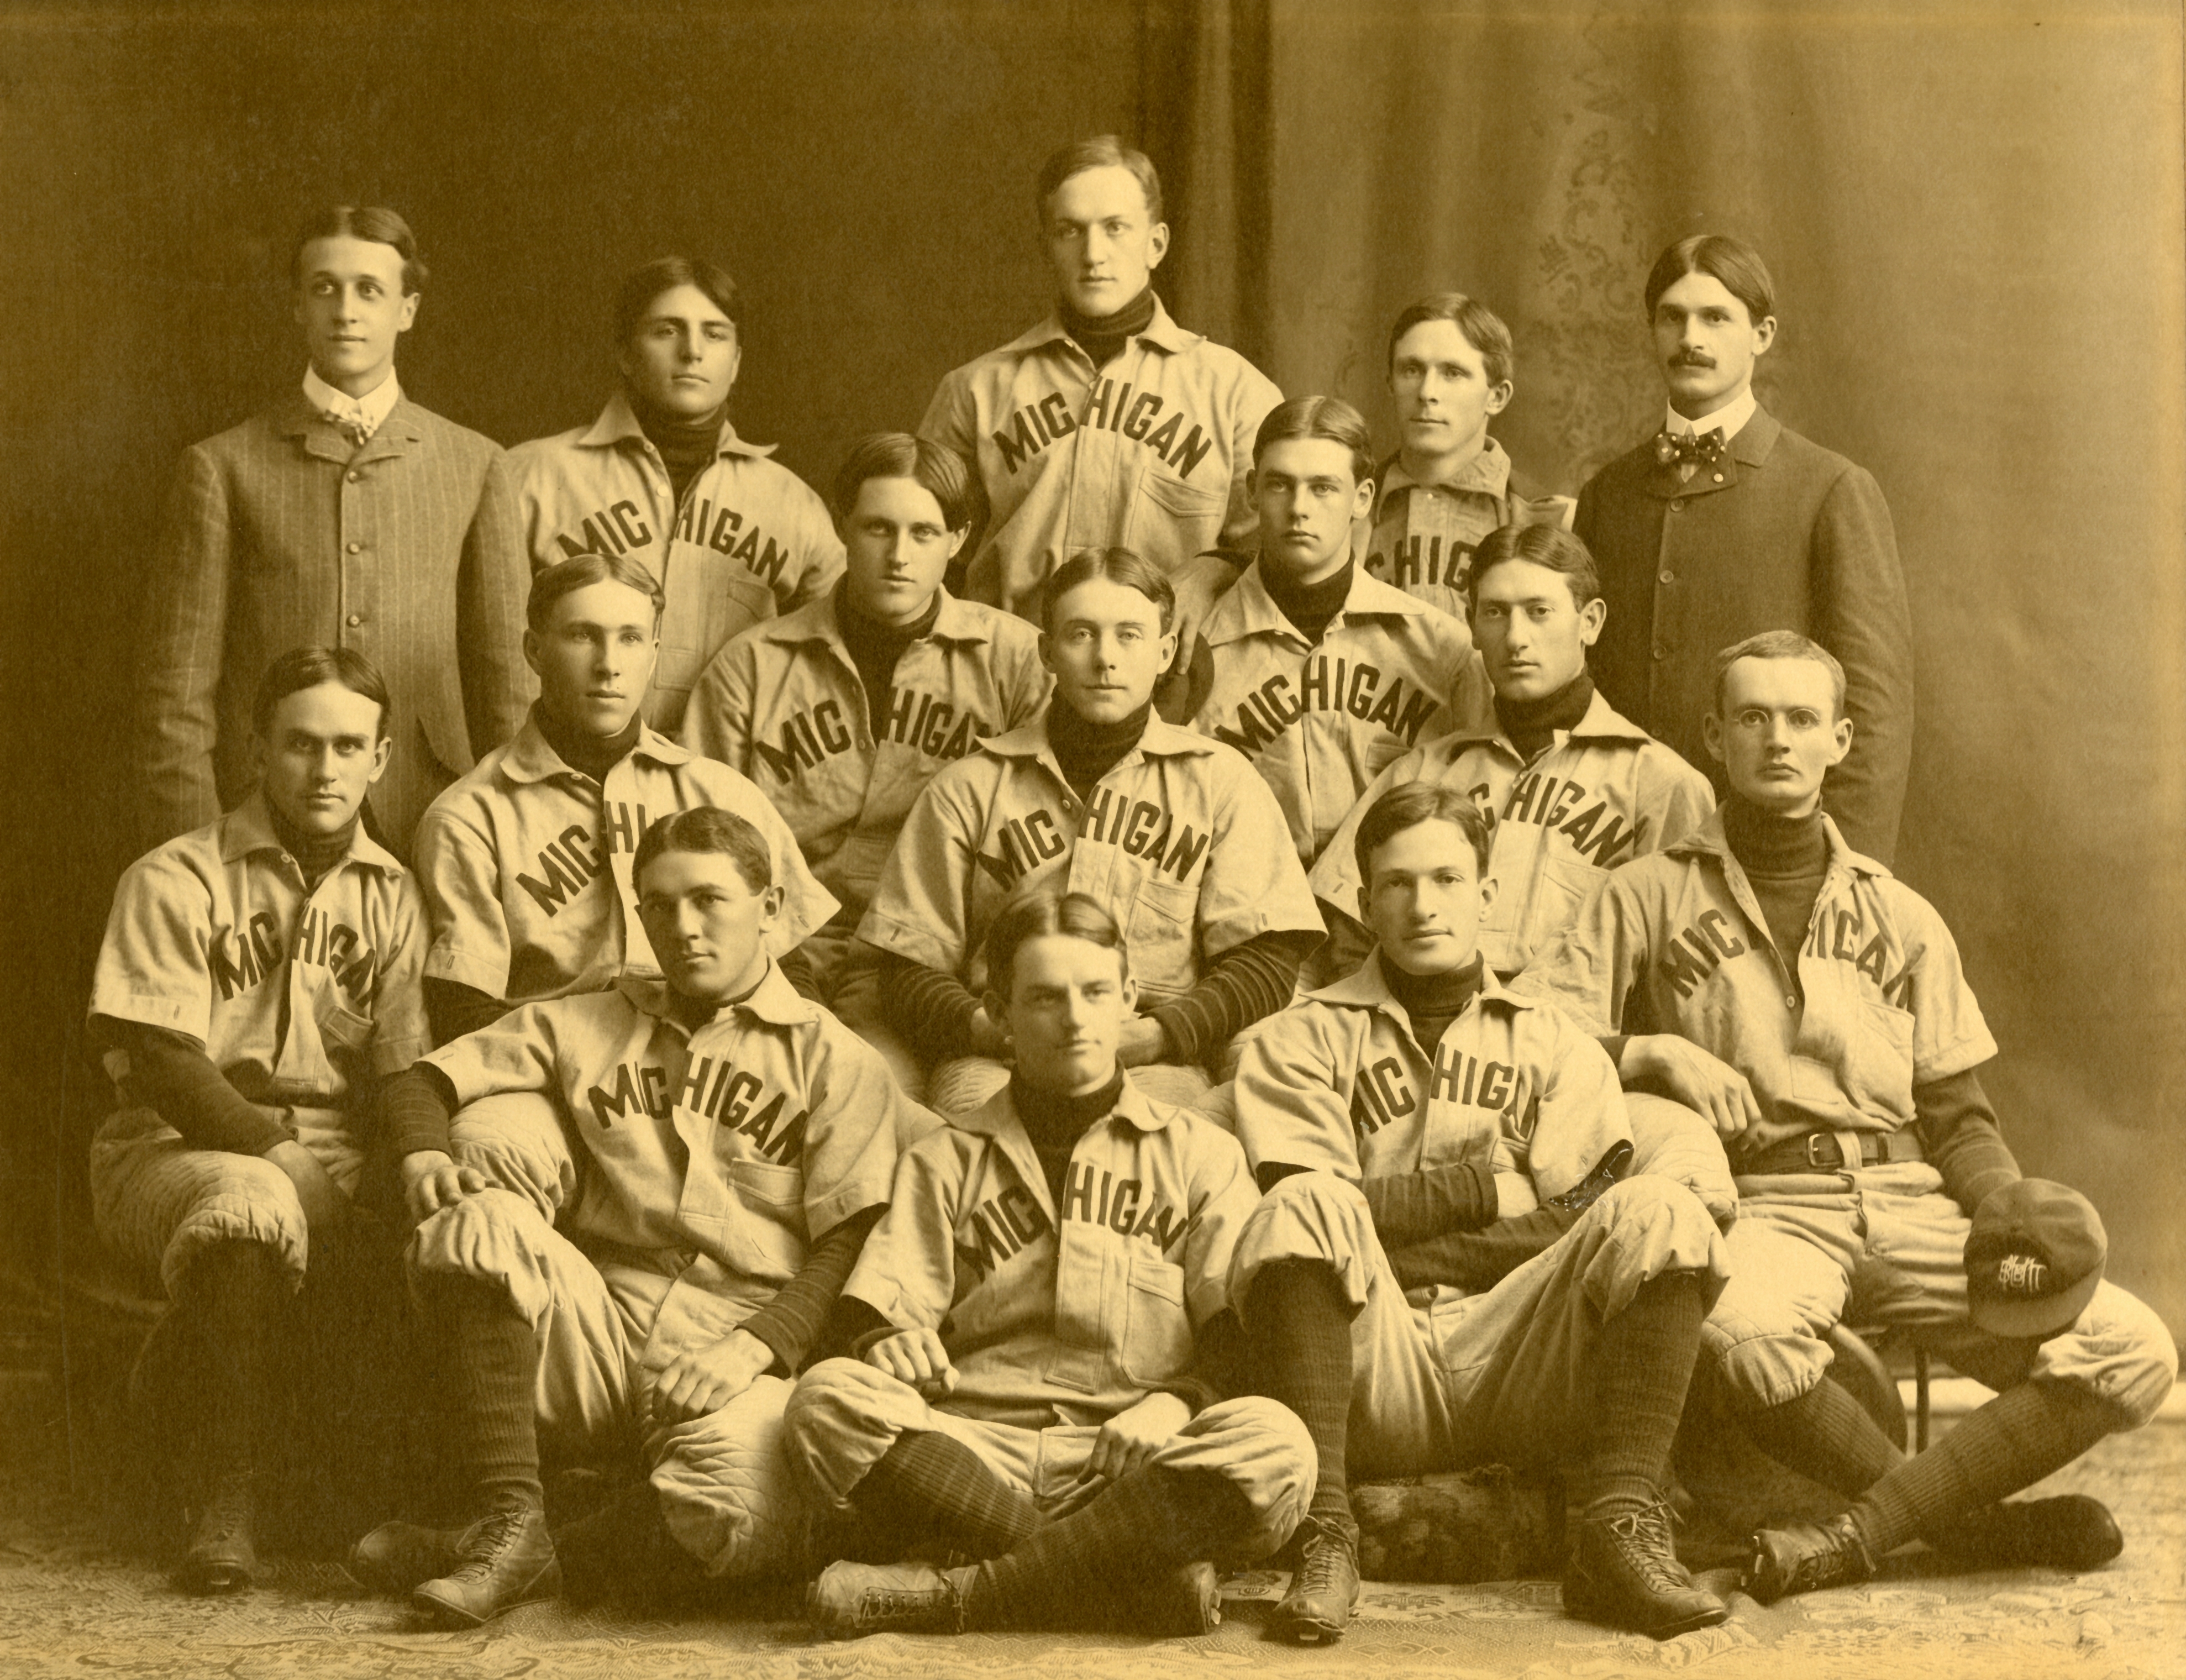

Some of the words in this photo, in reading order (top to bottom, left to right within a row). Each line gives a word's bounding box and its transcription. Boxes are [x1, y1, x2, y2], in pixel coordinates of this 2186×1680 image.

[992, 375, 1212, 480] MICHIGAN
[556, 498, 789, 589] MICHIGAN
[1214, 655, 1439, 762] MICHIGAN
[516, 800, 648, 917] MICHI
[976, 784, 1209, 893] MICHIGAN
[1468, 773, 1650, 868] CHIGAN
